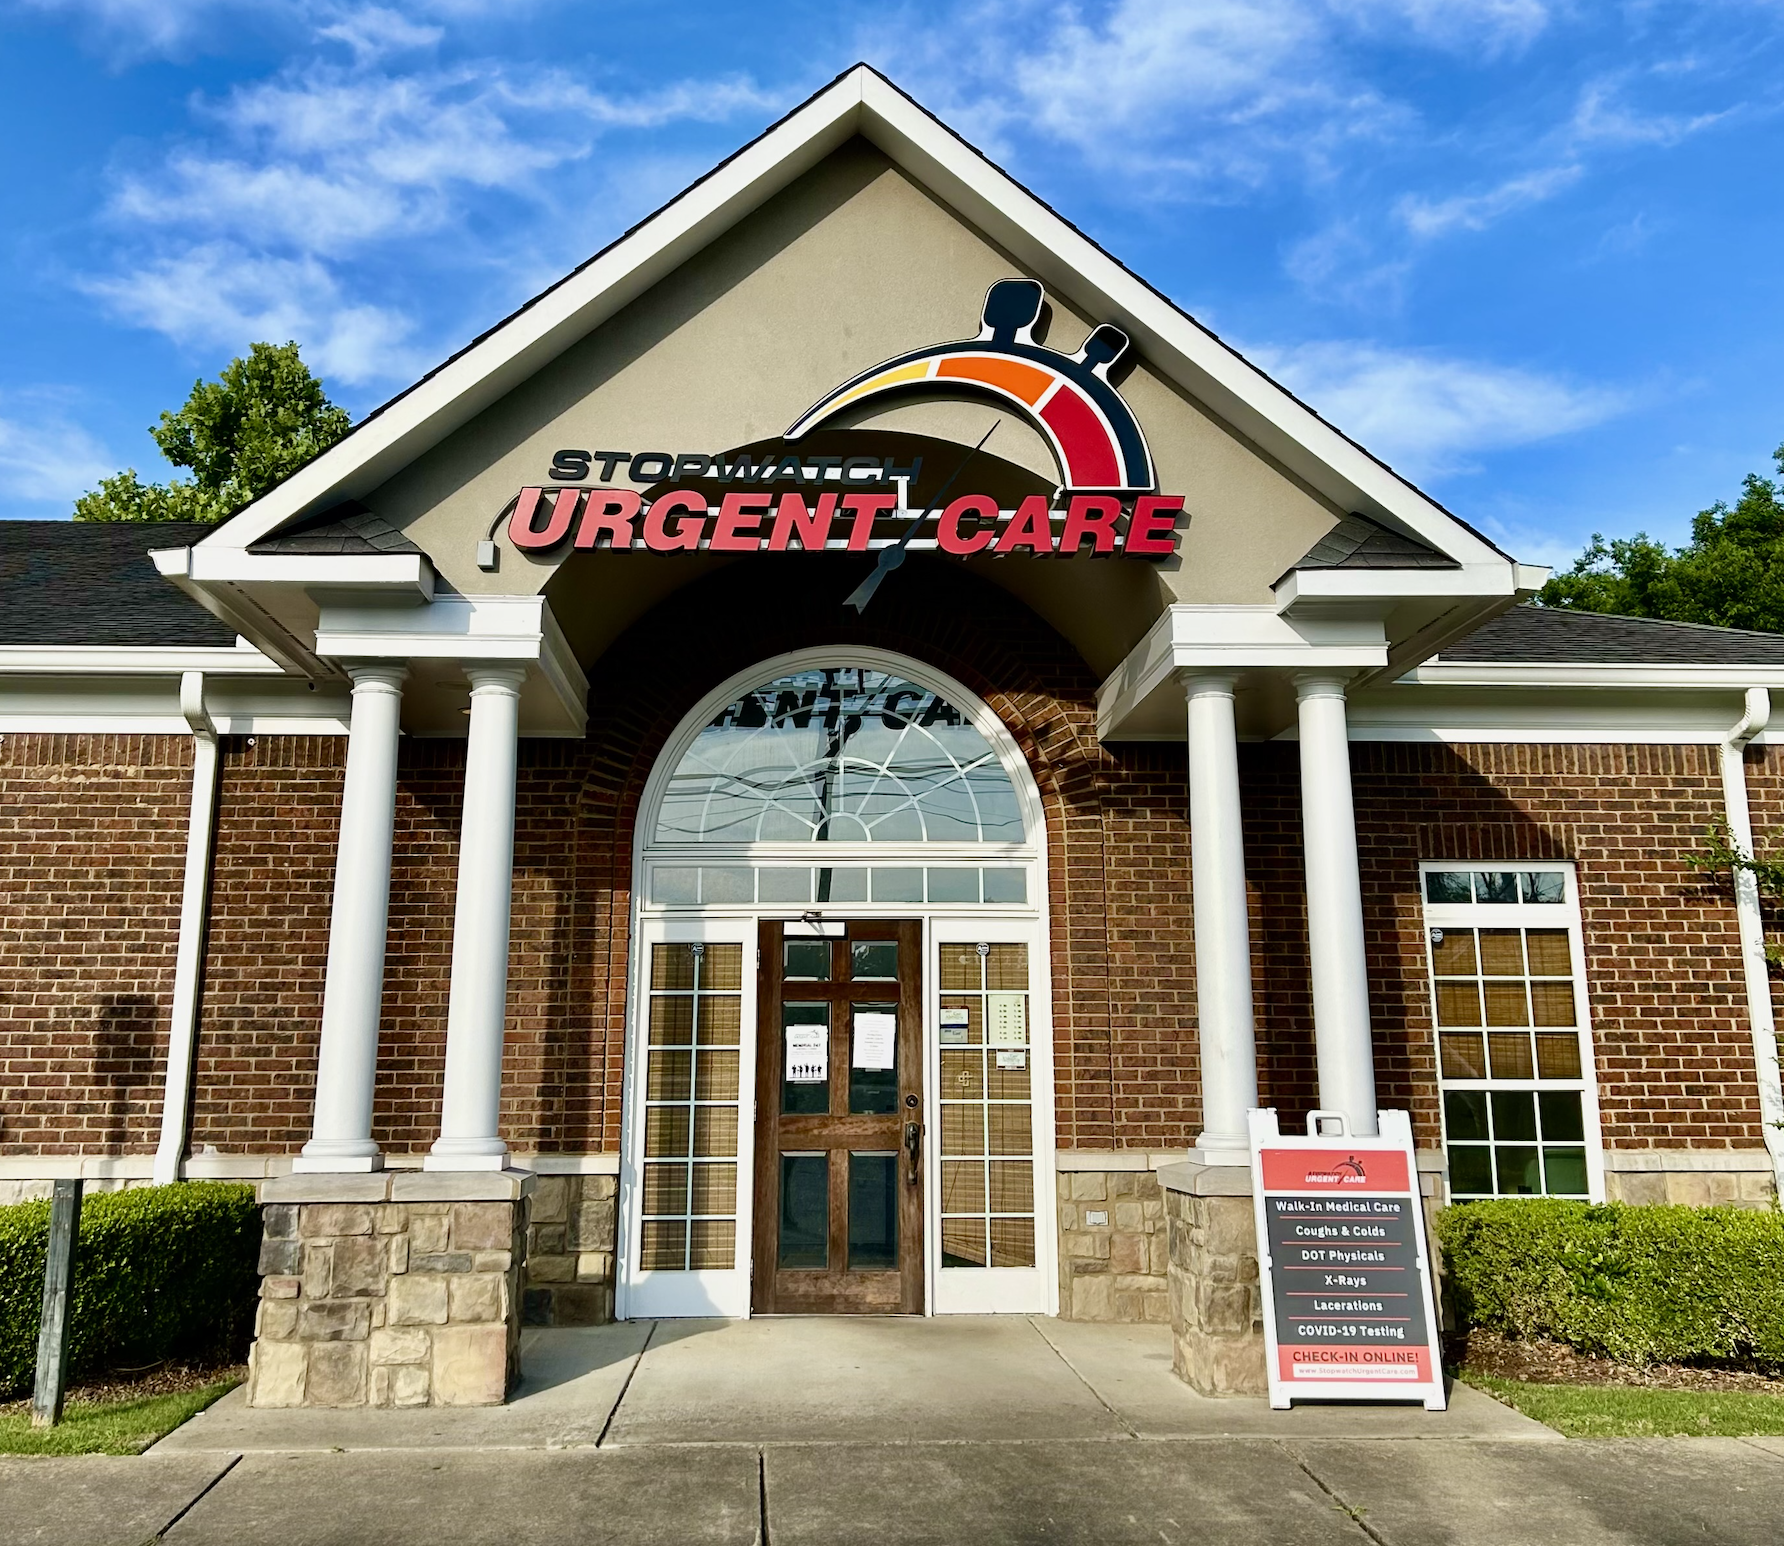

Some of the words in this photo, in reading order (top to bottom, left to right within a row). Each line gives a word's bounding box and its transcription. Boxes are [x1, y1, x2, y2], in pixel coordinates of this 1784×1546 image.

[548, 450, 923, 485] STOPWATCH
[508, 487, 898, 552] URGENT
[937, 494, 1186, 555] CARE
[1305, 1175, 1340, 1183] URGENT
[1343, 1175, 1367, 1183] CARE
[1275, 1201, 1322, 1212] Walk-In
[1326, 1201, 1372, 1212] Medical
[1373, 1202, 1401, 1212] Care
[1295, 1225, 1338, 1238] Coughs
[1341, 1225, 1350, 1236] &
[1353, 1226, 1386, 1237] Colds
[1301, 1250, 1325, 1260] DOT
[1329, 1250, 1385, 1263] Physicals
[1324, 1275, 1367, 1288] X-Rays
[1313, 1300, 1383, 1311] Lacerations
[1298, 1325, 1356, 1336] COVID-19
[1359, 1325, 1405, 1339] Testing
[1292, 1351, 1359, 1362] CHECK-IN
[1363, 1352, 1419, 1362] ONLINE!
